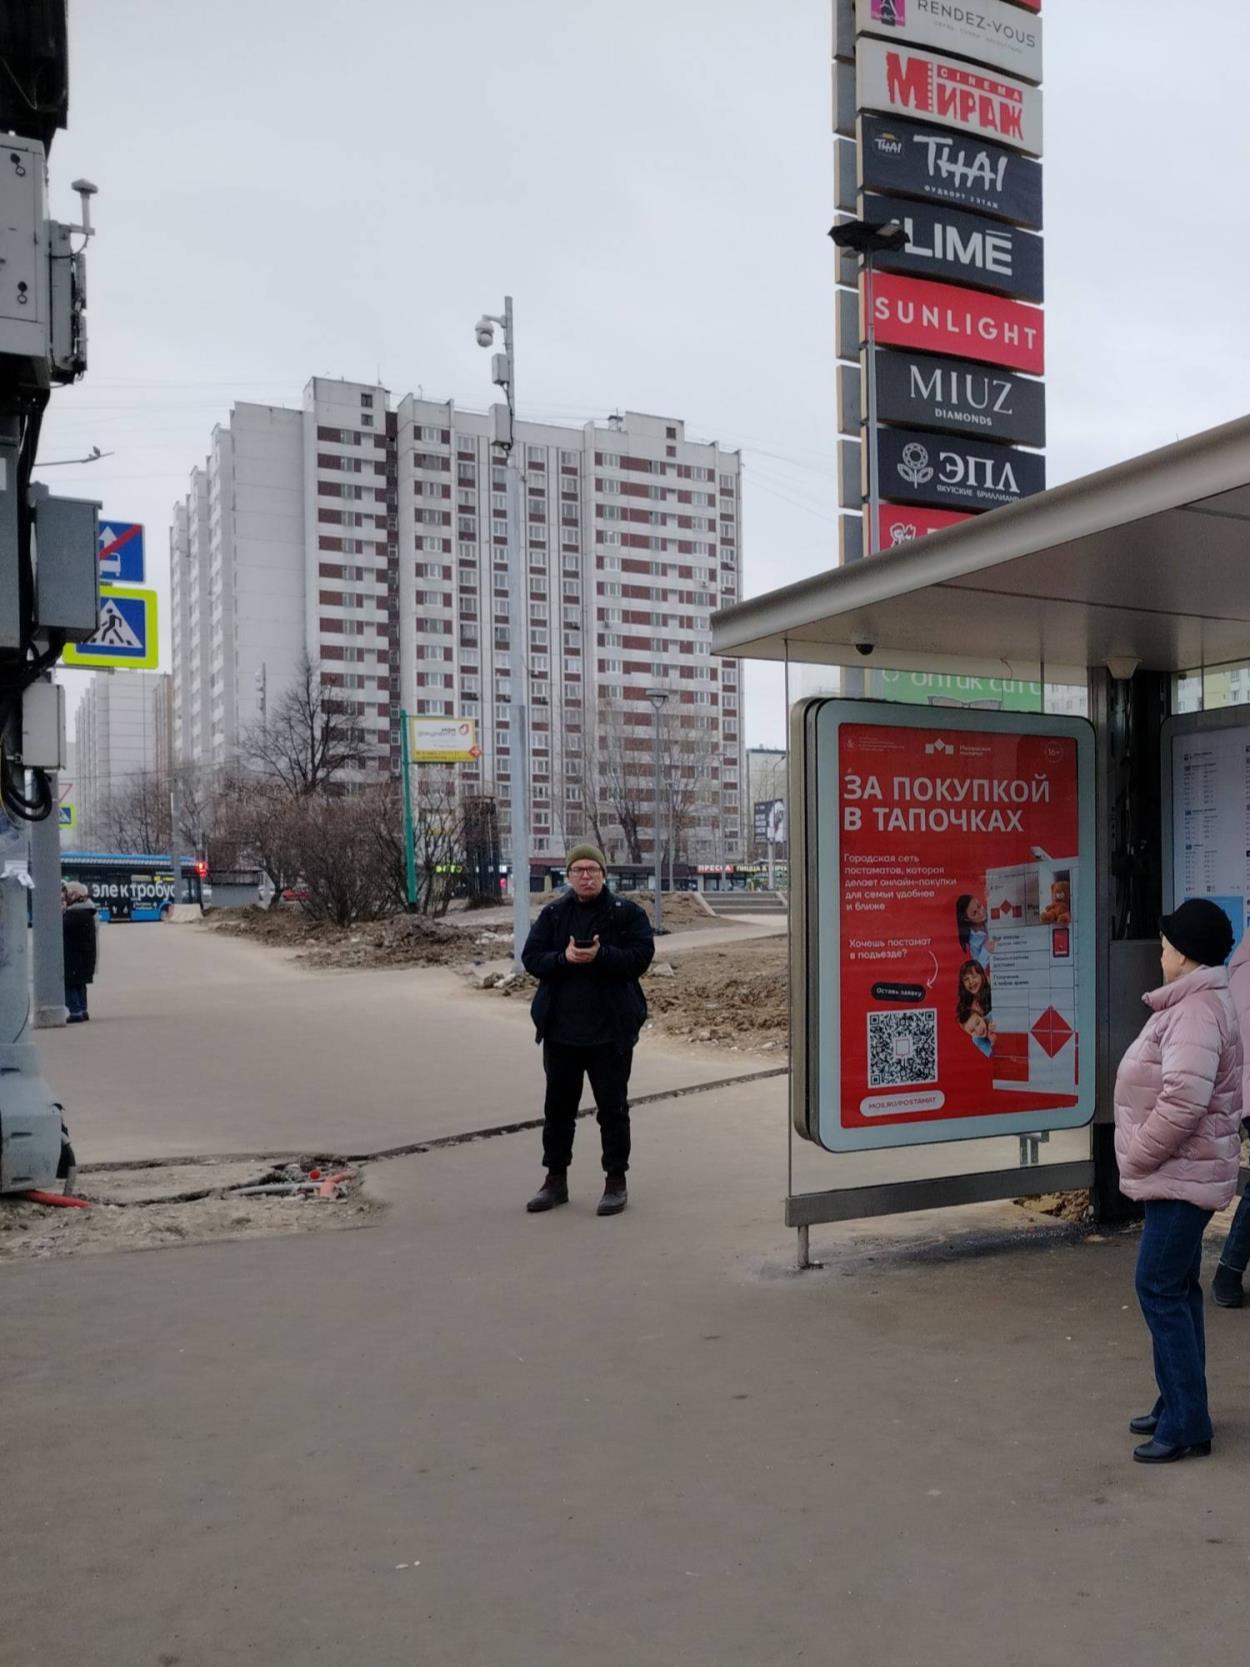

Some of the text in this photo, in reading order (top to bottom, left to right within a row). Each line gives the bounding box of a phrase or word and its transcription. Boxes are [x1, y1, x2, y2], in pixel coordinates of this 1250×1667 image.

[917, 0, 1036, 48] RENDEZ-VOUS
[937, 64, 1023, 104] CINEMA
[913, 134, 1008, 191] THAI
[875, 297, 1036, 350] SUNLIGHT
[909, 364, 1013, 415] MIUZ
[935, 408, 992, 426] DIAMONDS
[938, 452, 1020, 494] ЭПЛ
[844, 773, 1050, 803] ЗА ПОКУПКОЙ
[844, 807, 1024, 832] В ТАПОЧКАХ
[697, 864, 734, 873] ПРЕСА
[844, 853, 920, 864] Городская сеть
[906, 867, 944, 875] которая
[845, 879, 877, 888] делает
[846, 891, 862, 899] для
[896, 889, 935, 900] удобнее
[855, 902, 885, 911] ближе
[849, 938, 932, 948] Хочешь постамат
